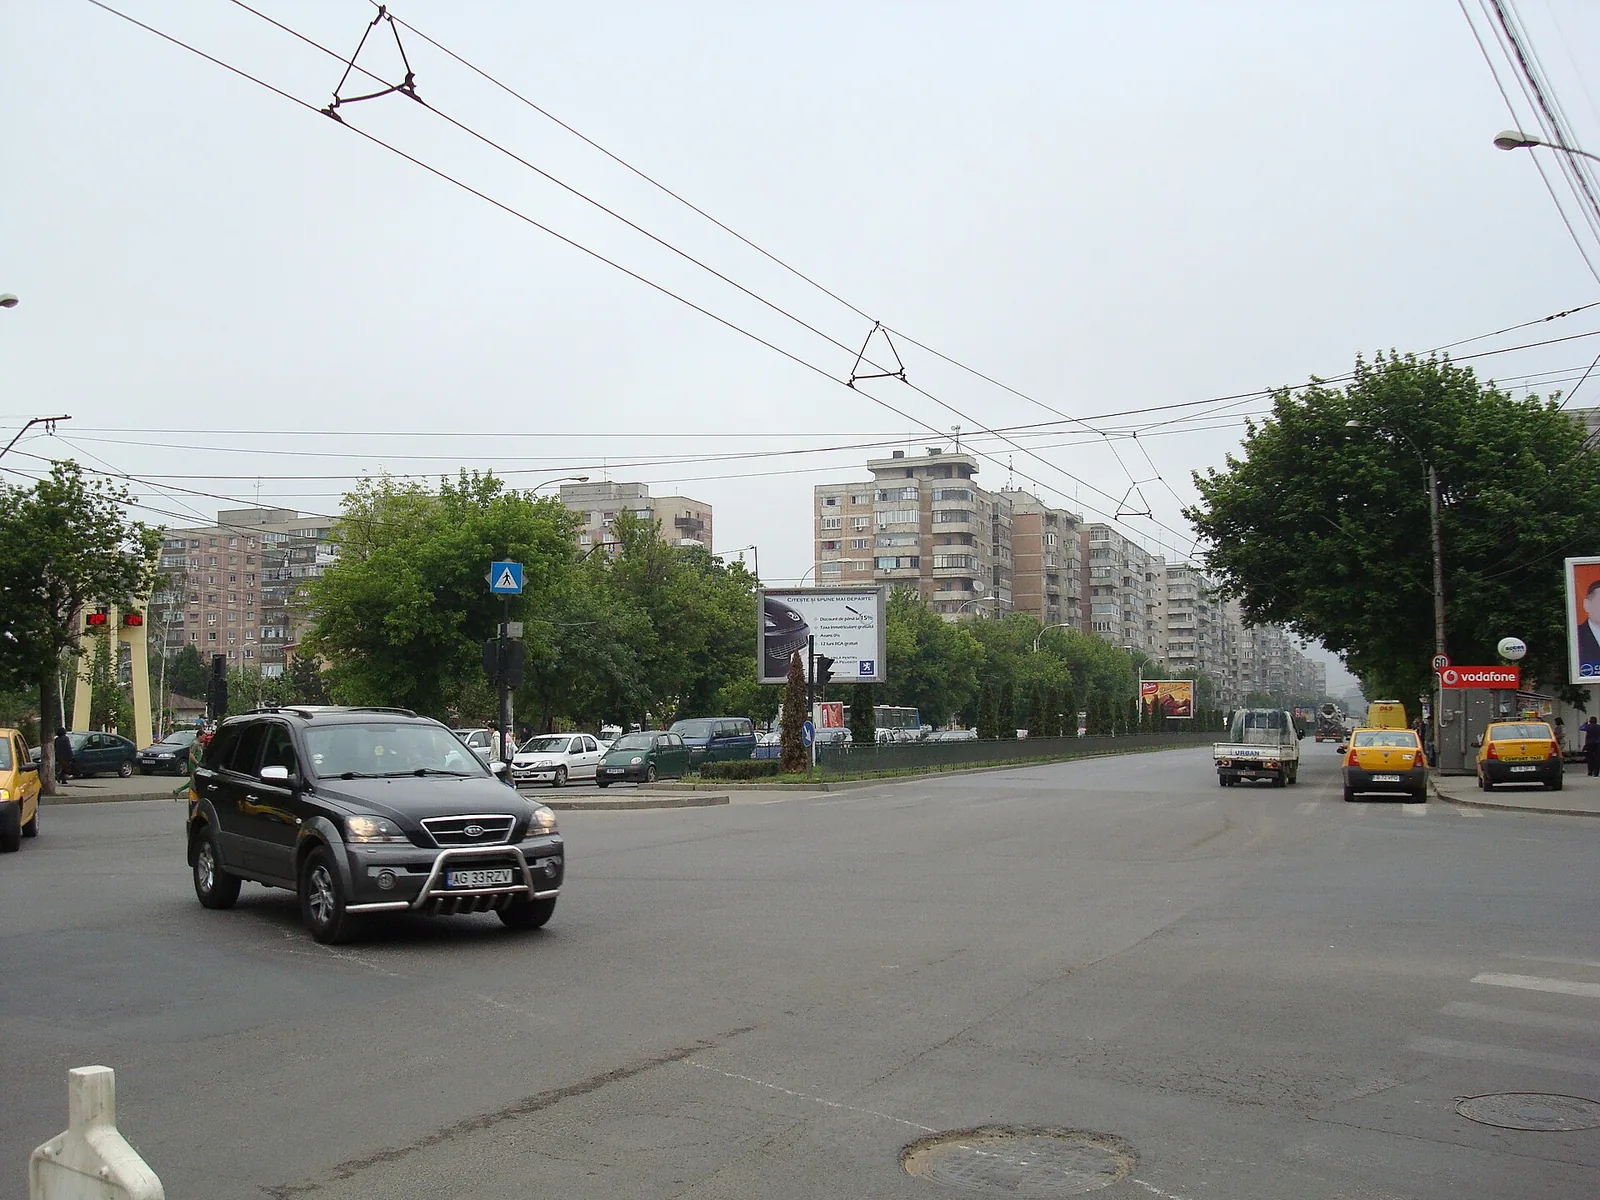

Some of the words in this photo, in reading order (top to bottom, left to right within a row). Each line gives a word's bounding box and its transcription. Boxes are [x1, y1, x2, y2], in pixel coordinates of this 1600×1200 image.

[1435, 658, 1446, 667] 60
[1461, 672, 1515, 682] vodafone
[454, 872, 467, 884] AG
